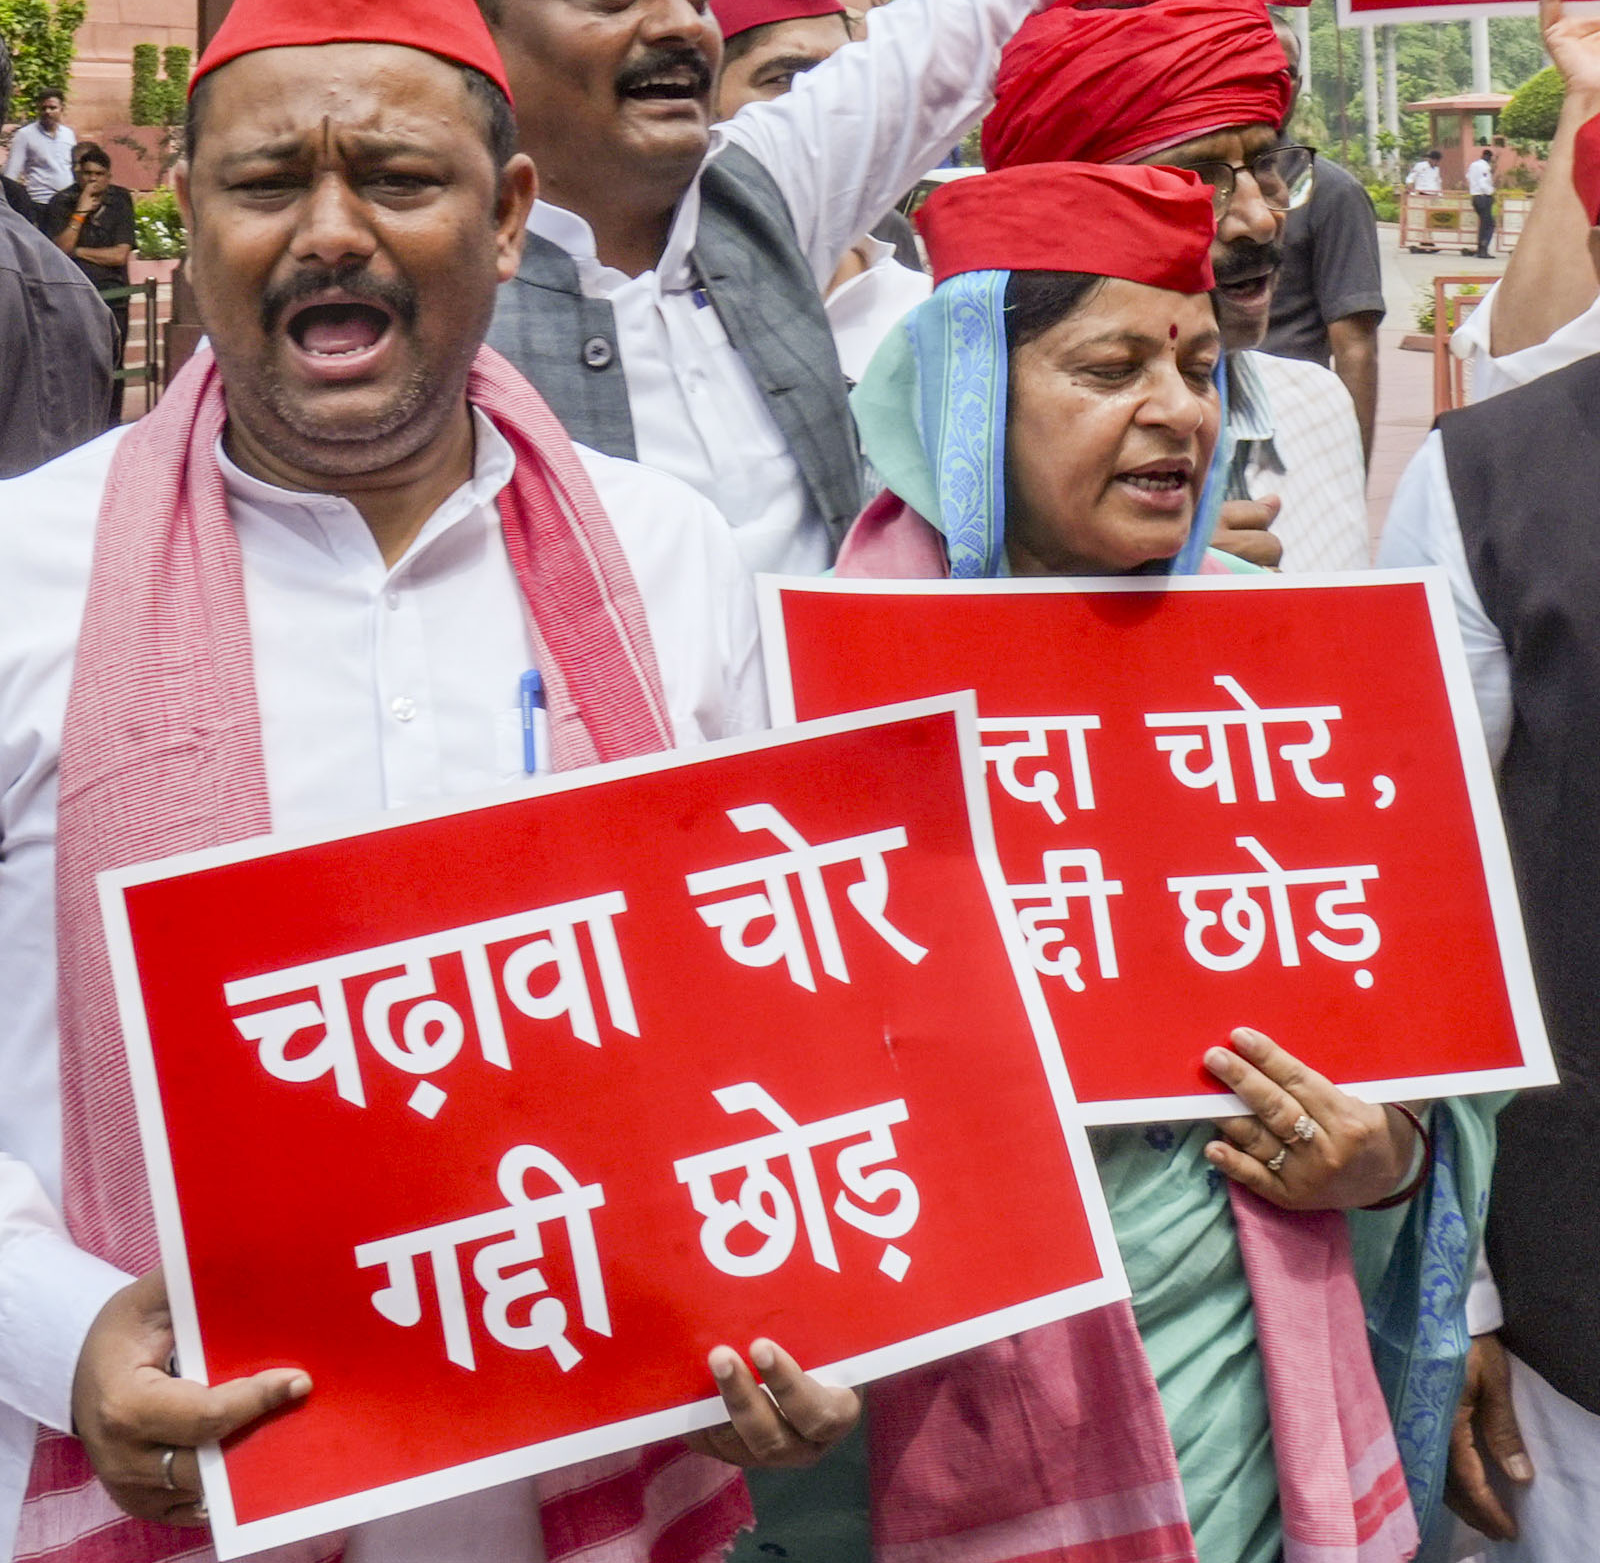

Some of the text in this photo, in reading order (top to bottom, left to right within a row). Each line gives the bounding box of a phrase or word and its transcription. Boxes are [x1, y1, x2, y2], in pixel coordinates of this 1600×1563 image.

[224, 804, 928, 1119] चढ़ावा चोर
[1006, 836, 1381, 993] द्दी छोड़
[355, 1082, 920, 1372] गद्दी छोड़
